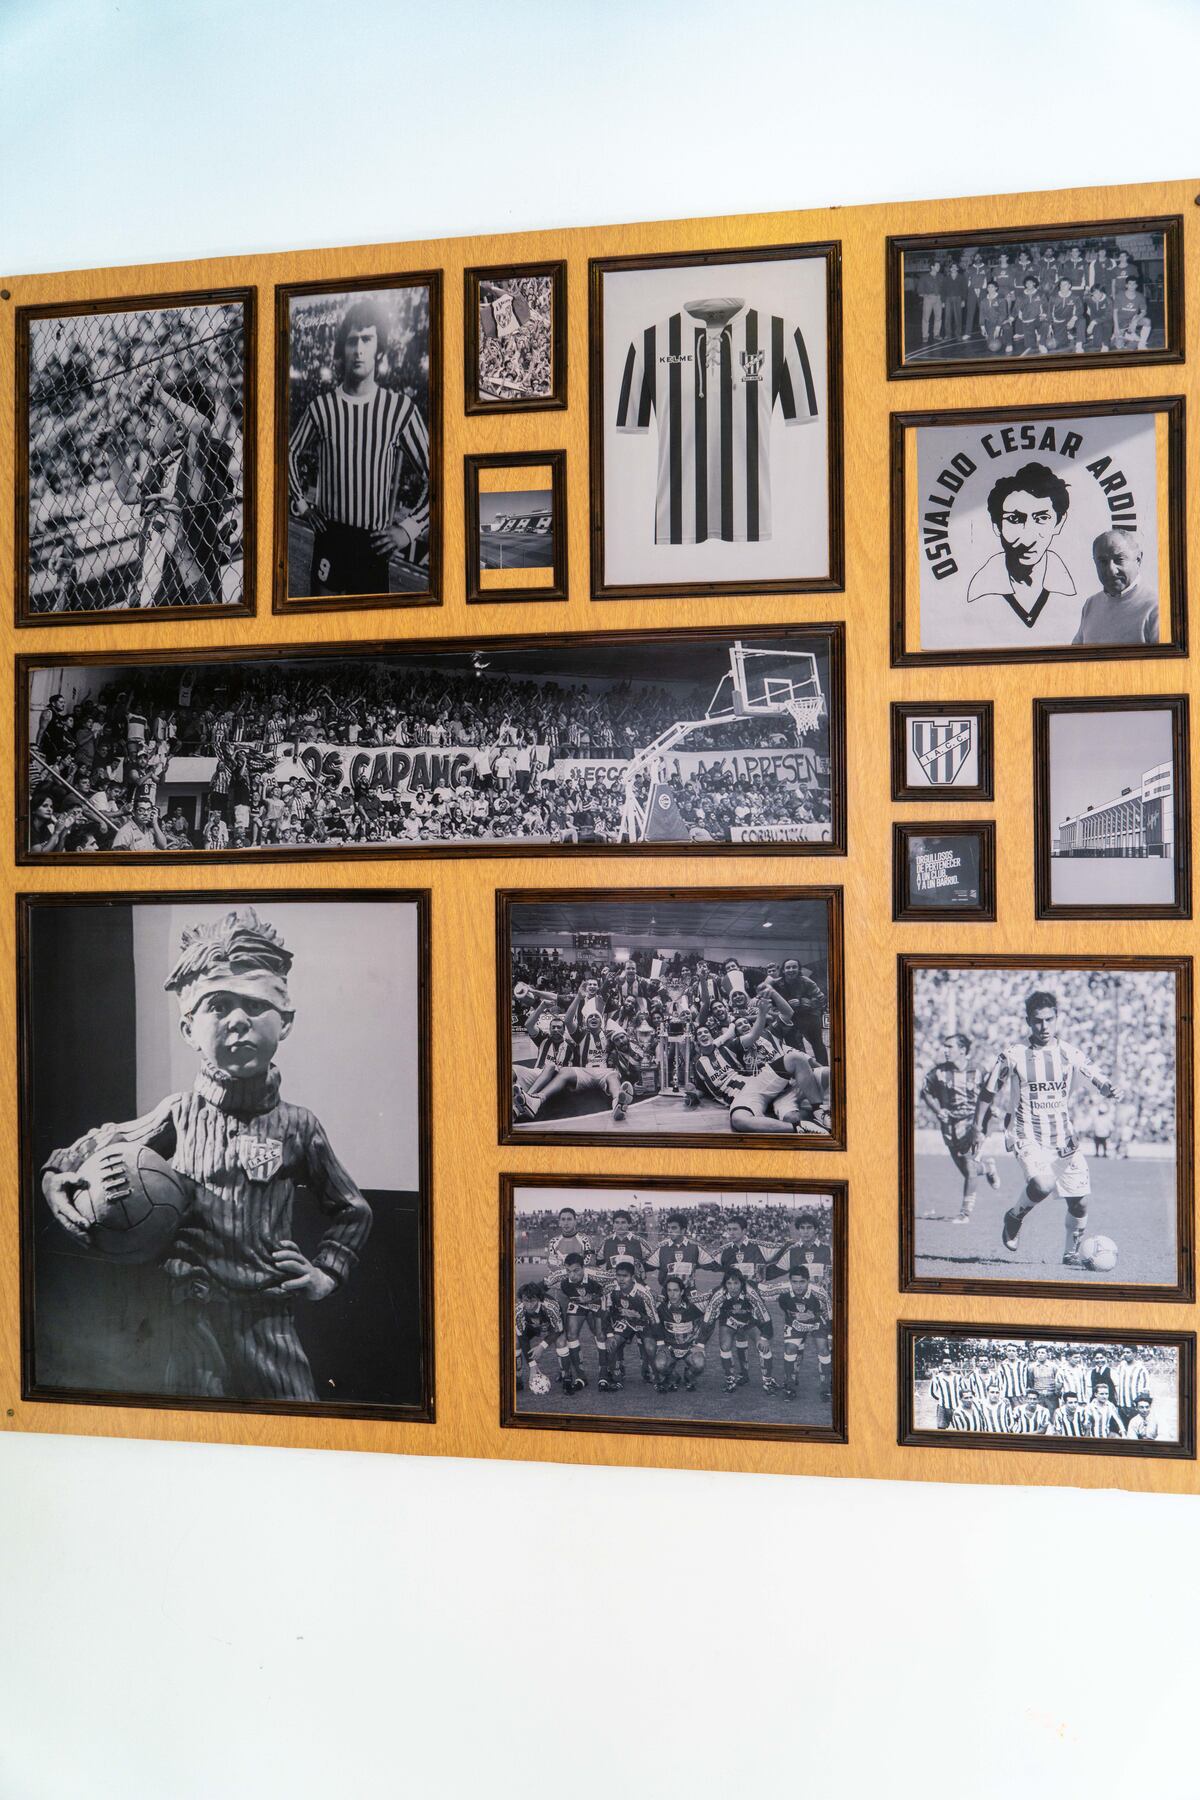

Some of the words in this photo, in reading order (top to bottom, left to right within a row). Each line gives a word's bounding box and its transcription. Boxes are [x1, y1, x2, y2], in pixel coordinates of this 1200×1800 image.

[659, 354, 693, 363] KELME
[923, 452, 977, 580] OSVALDO
[980, 425, 1084, 459] CESAR
[318, 558, 331, 582] 9
[916, 863, 925, 874] DE
[710, 1064, 732, 1082] BRAVA
[1028, 1081, 1067, 1092] BRAVA
